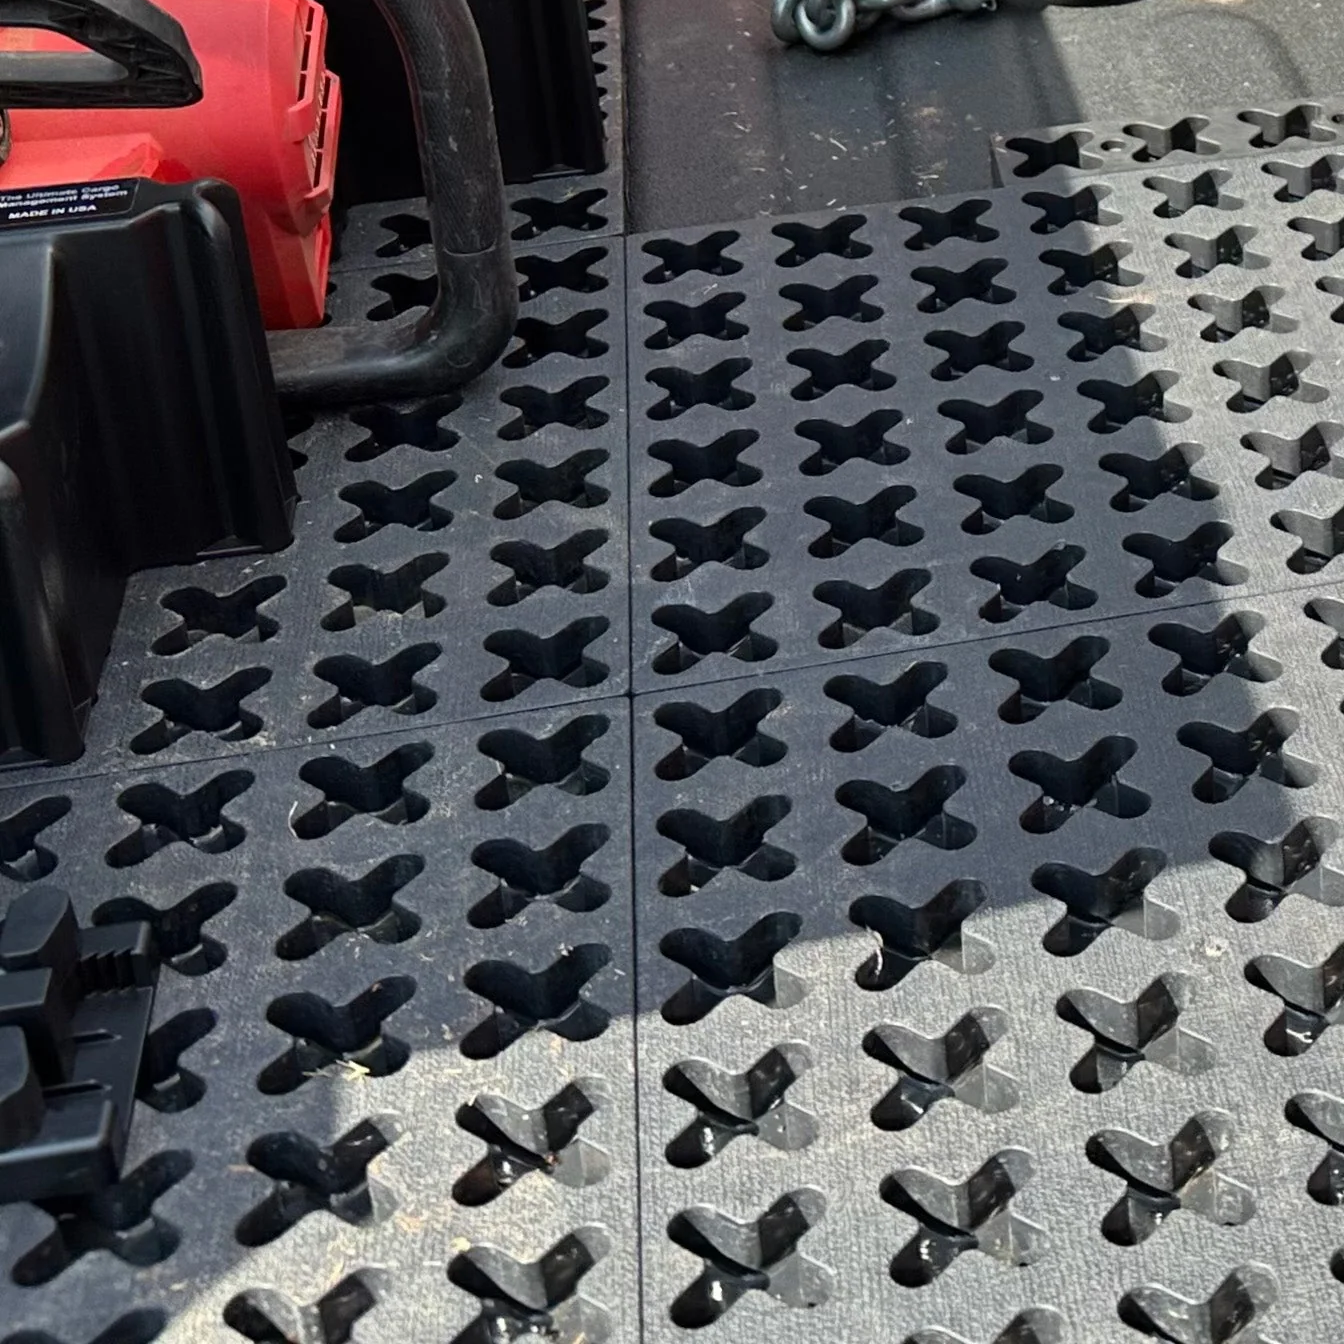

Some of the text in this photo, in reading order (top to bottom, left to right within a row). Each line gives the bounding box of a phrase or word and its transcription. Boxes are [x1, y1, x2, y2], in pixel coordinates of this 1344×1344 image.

[26, 189, 78, 200] Ultimate
[81, 184, 120, 195] Cargo
[81, 190, 128, 201] System
[8, 204, 97, 219] MADE IN USA
